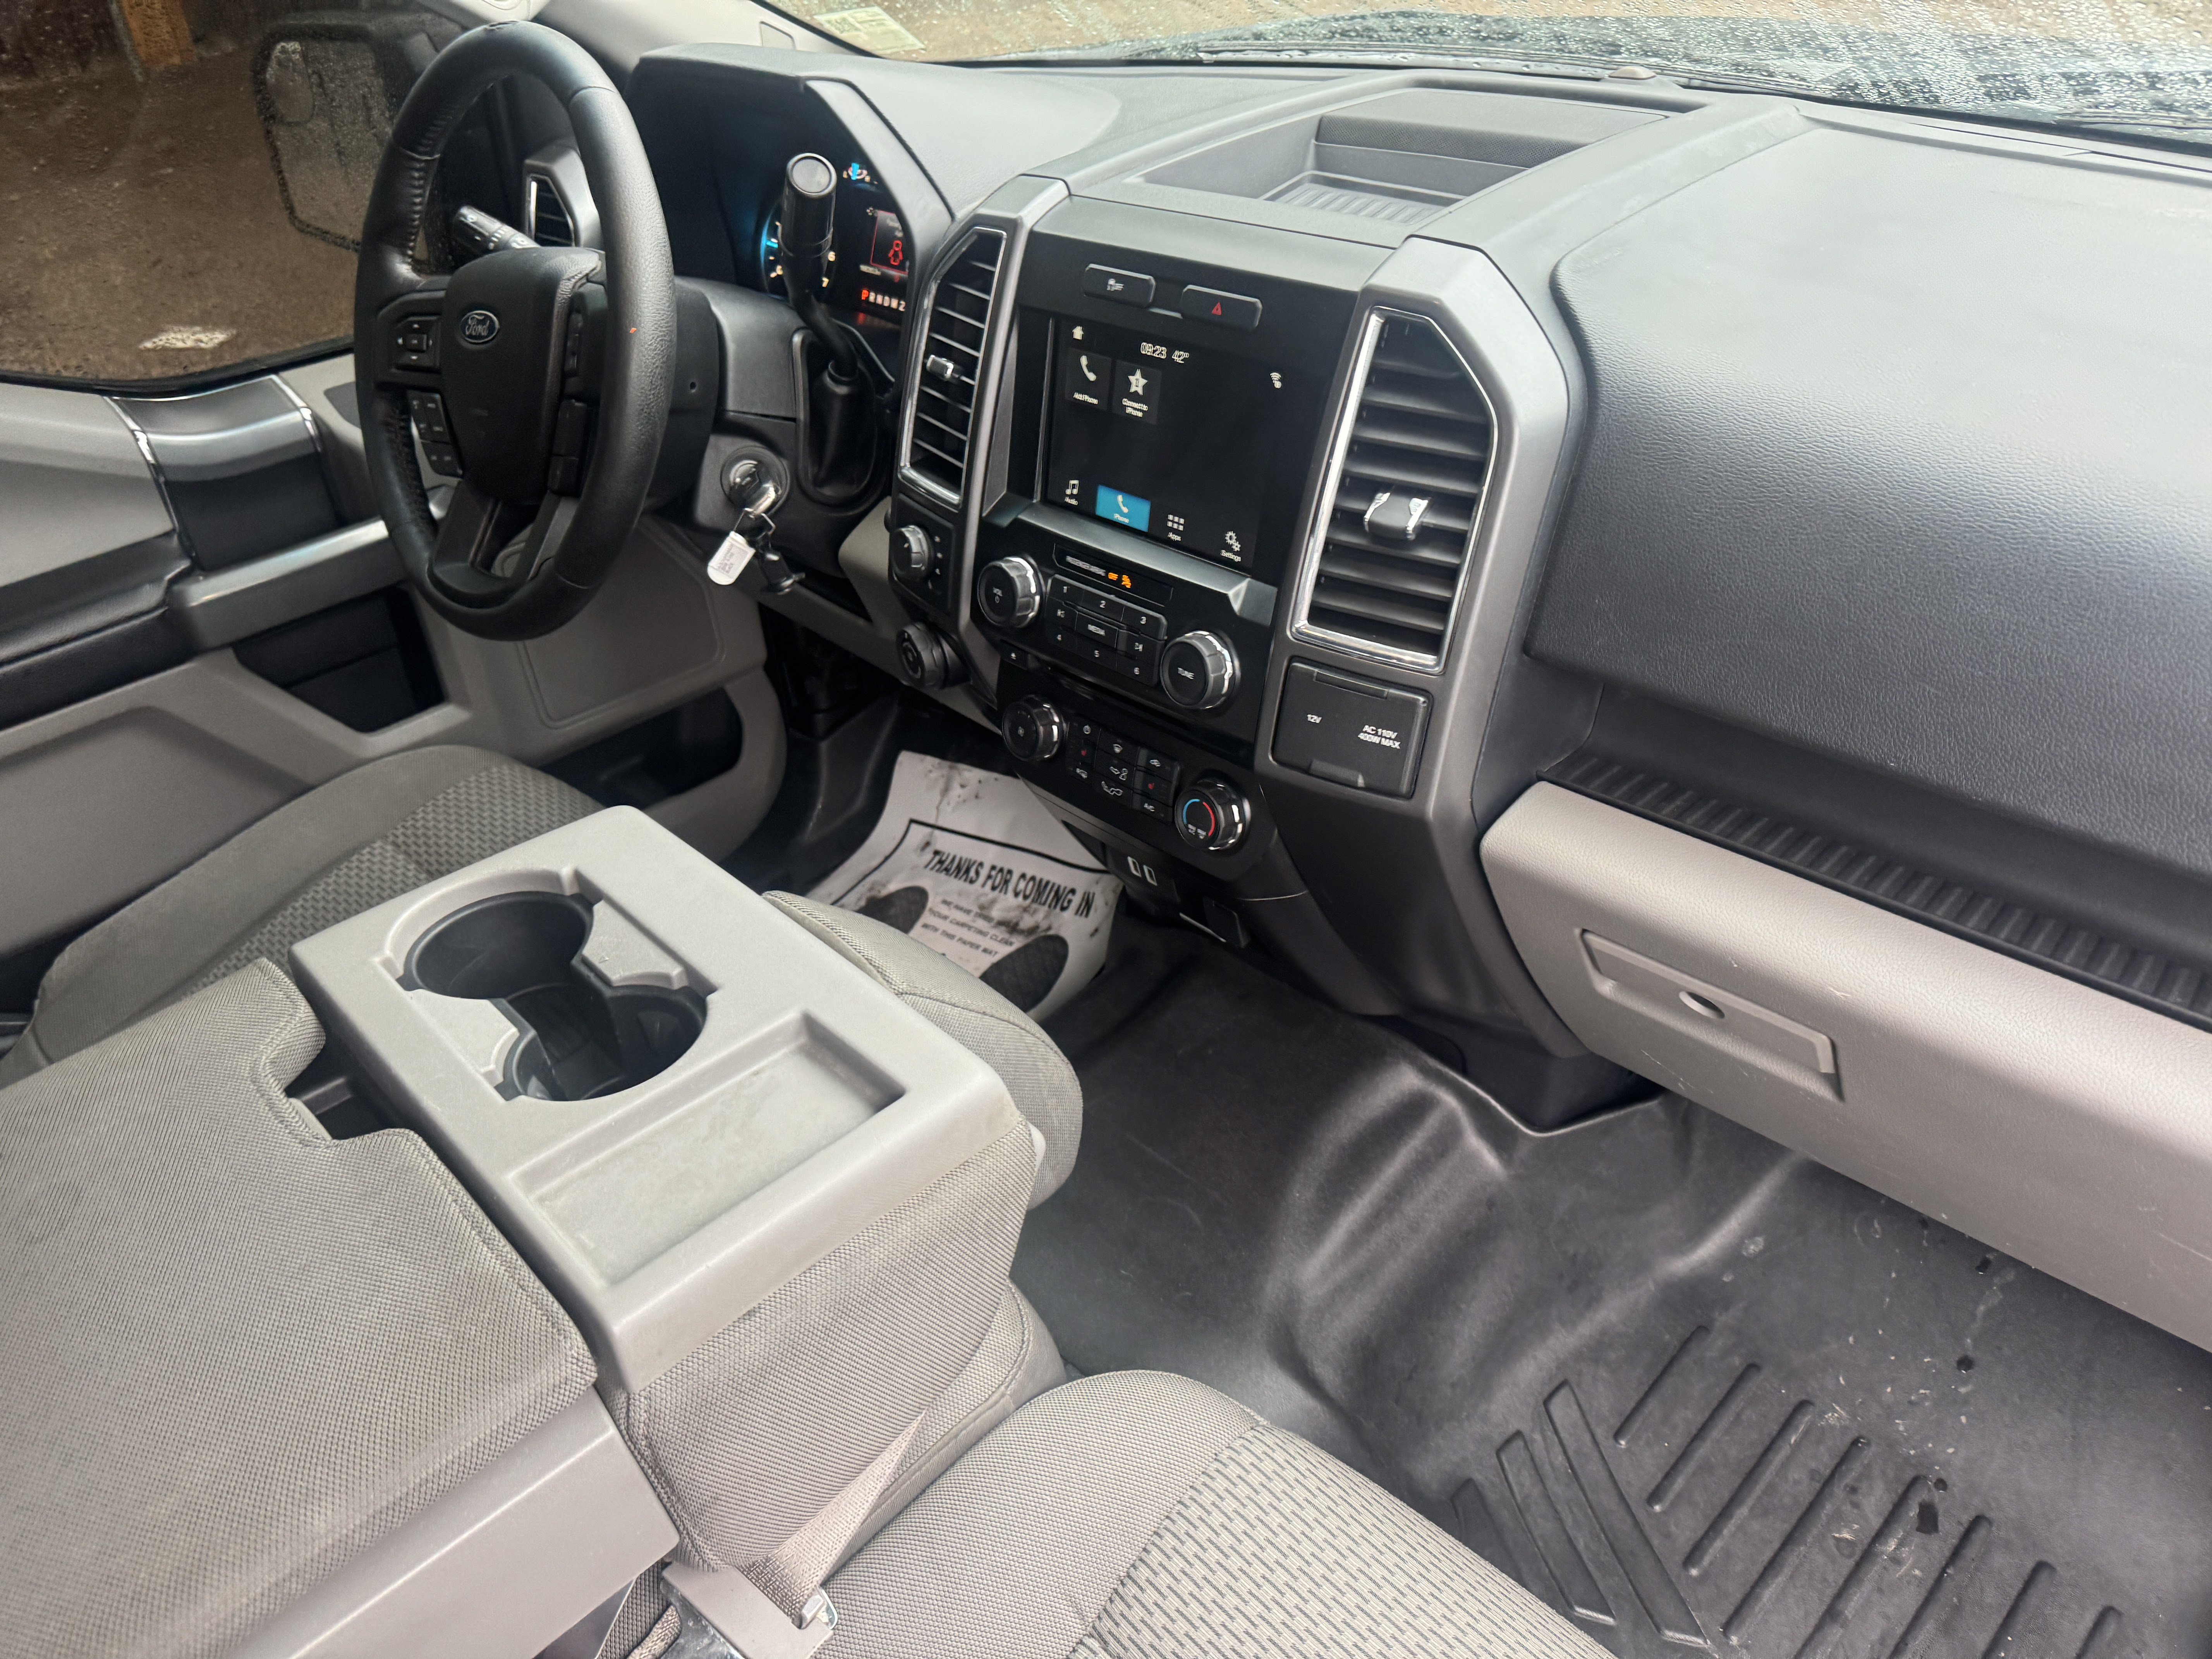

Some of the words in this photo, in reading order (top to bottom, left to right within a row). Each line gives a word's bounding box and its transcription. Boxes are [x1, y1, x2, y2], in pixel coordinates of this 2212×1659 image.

[465, 314, 490, 337] Ford
[1168, 532, 1181, 541] Apps
[1220, 550, 1242, 562] Settings
[1307, 714, 1322, 723] 12V
[1362, 725, 1376, 734] AC
[1380, 737, 1401, 749] MAX
[924, 850, 984, 884] THANKS
[981, 864, 1013, 896] FOR
[1014, 872, 1077, 912] COMING
[1075, 891, 1096, 918] IN
[990, 934, 1015, 947] CLEAN
